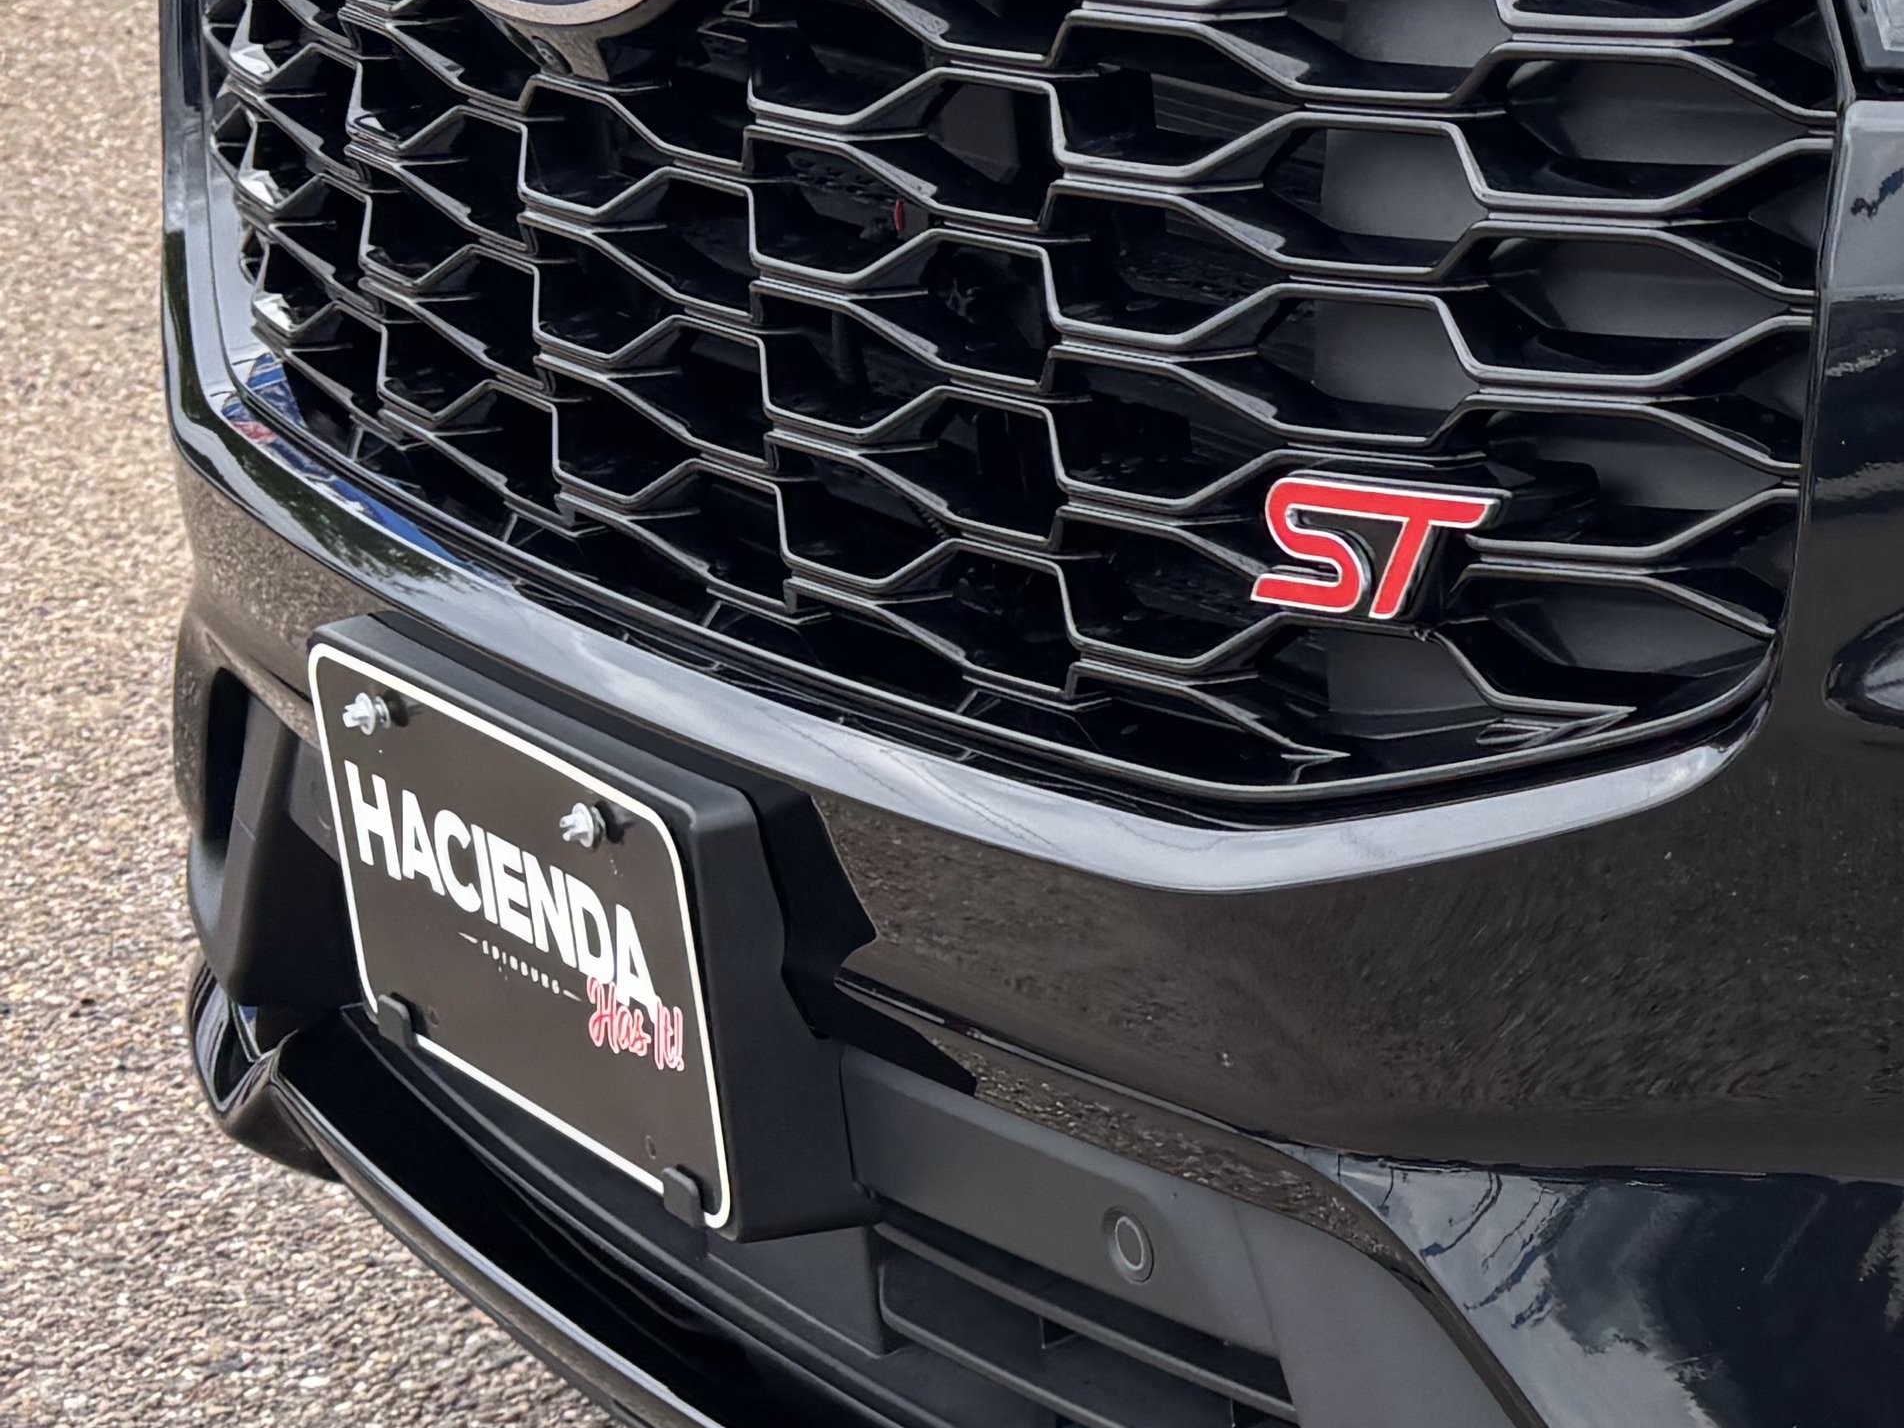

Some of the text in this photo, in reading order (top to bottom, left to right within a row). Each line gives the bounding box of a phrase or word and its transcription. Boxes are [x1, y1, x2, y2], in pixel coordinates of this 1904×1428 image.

[1250, 471, 1508, 620] ST
[344, 760, 659, 1024] HACIENDA
[586, 976, 652, 1057] Has
